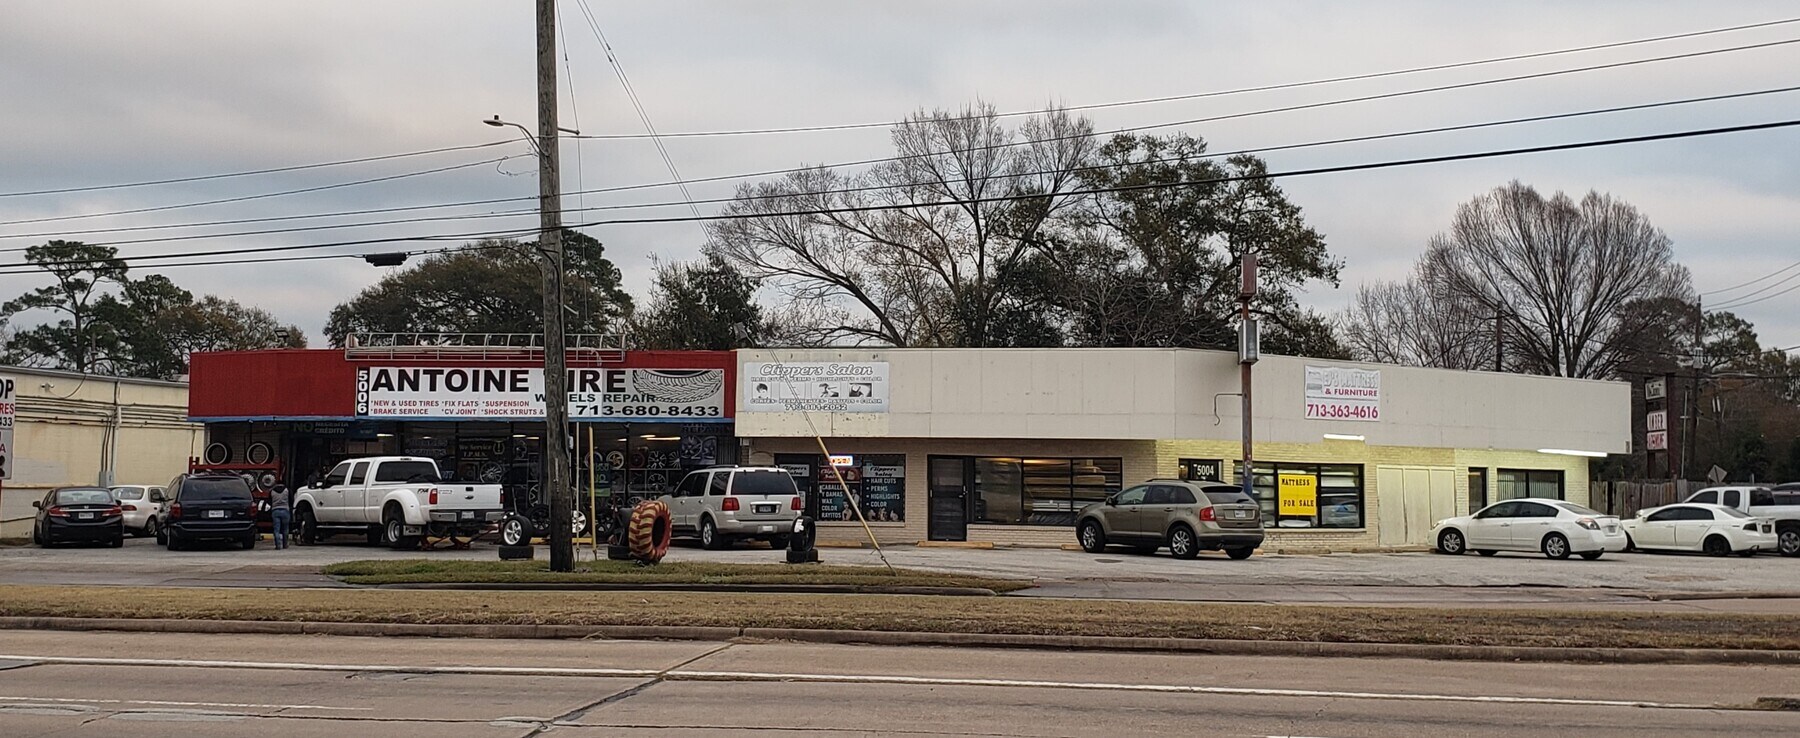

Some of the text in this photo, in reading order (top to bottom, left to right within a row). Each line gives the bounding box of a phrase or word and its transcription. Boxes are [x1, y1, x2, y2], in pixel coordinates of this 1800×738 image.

[760, 364, 873, 378] Clippers Salon
[371, 369, 626, 392] ANTOINE IRE
[535, 393, 655, 403] WELS REPAIR
[1334, 389, 1378, 397] FURNITURE
[576, 405, 720, 416] 713-680-8433
[1307, 404, 1378, 418] 713-363-4616
[1197, 465, 1215, 476] 5004
[1281, 478, 1310, 486] MATTRESS
[1299, 499, 1314, 507] SALE
